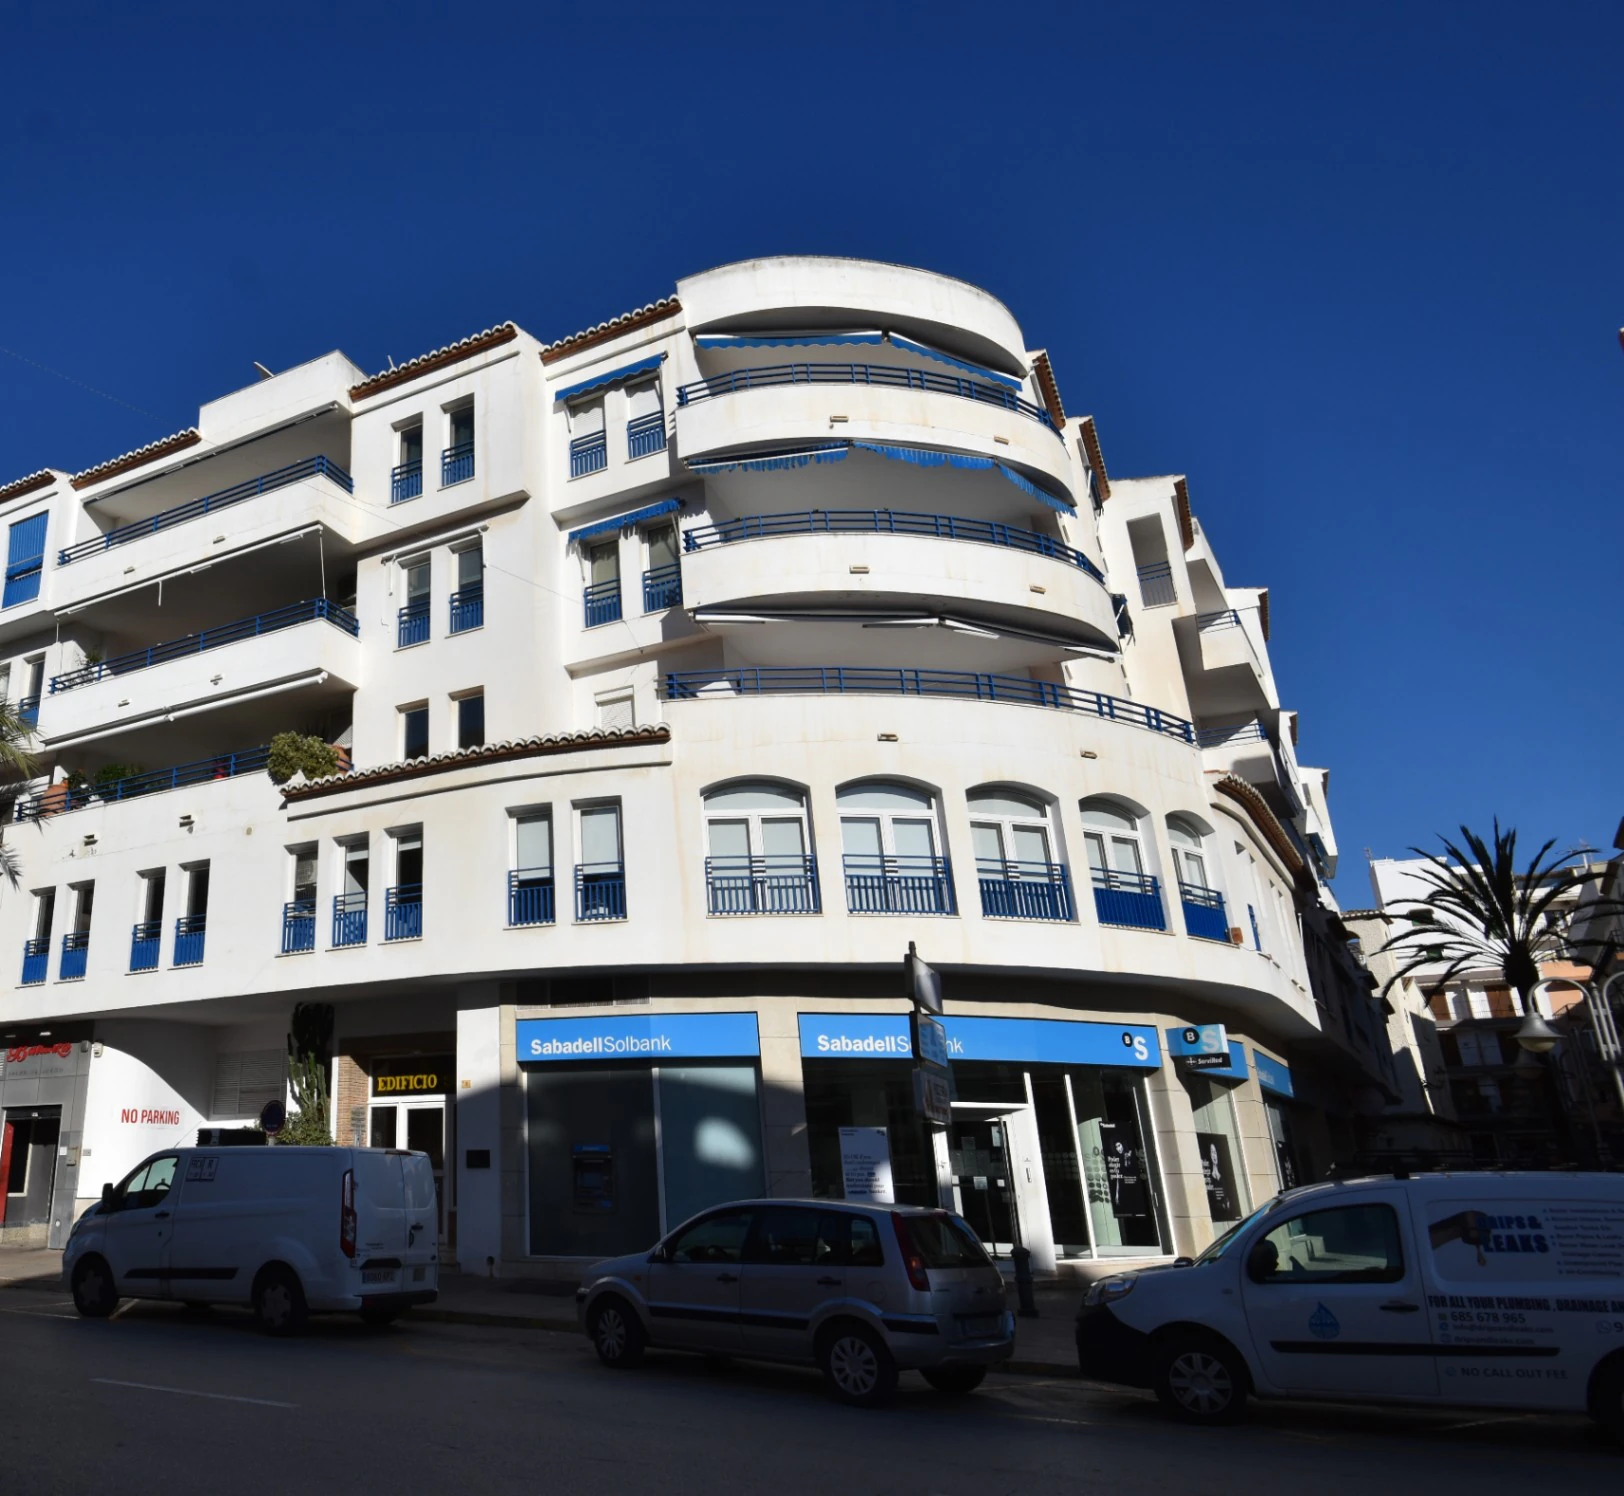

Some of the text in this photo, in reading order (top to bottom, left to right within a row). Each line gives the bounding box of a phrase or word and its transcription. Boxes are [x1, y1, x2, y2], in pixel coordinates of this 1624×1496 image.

[530, 1034, 672, 1055] SabadellSolbank
[817, 1034, 964, 1054] SabadellSnk
[1133, 1036, 1149, 1061] S
[1202, 1030, 1220, 1052] S
[377, 1074, 438, 1092] EDIFICIO
[121, 1108, 180, 1125] NO PARKING
[1477, 1215, 1526, 1230] DRIPS
[1482, 1234, 1550, 1252] LEAKS
[1428, 1295, 1448, 1308] FOR
[1449, 1295, 1467, 1309] ALL
[1468, 1296, 1495, 1309] YOUR
[1497, 1297, 1551, 1312] PLUMBING
[1451, 1312, 1473, 1322] 685
[1502, 1313, 1527, 1324] 965
[1461, 1367, 1569, 1380] NO CALL OUT FEE
